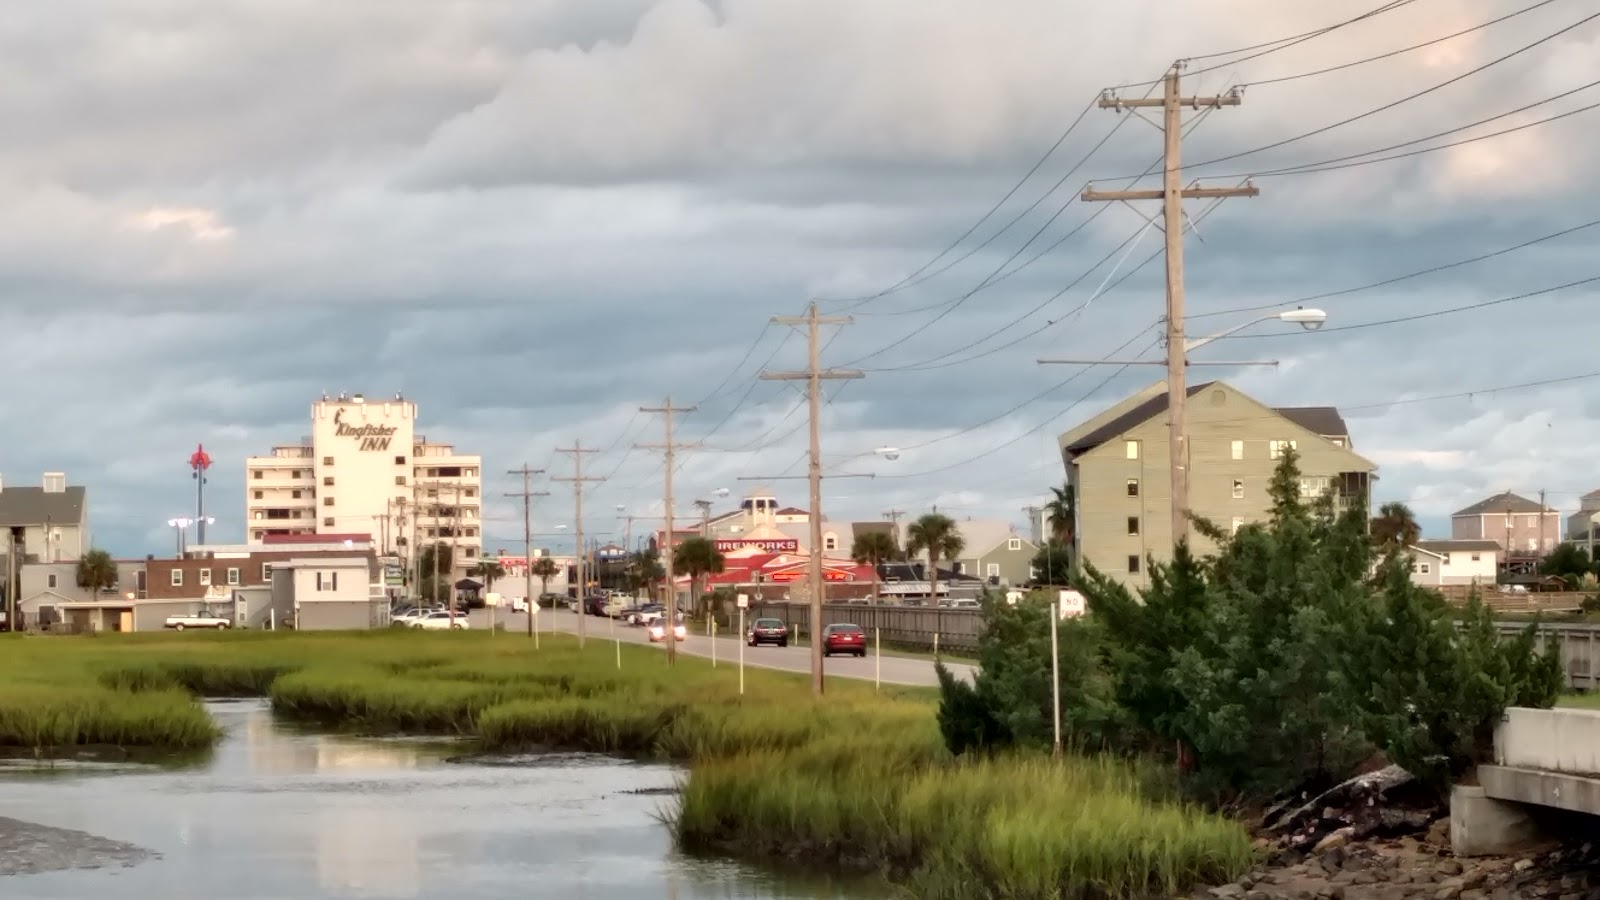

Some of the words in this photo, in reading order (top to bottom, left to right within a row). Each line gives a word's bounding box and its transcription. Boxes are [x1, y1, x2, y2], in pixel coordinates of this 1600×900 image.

[336, 422, 398, 440] Kingfisher
[359, 438, 392, 451] INN
[717, 541, 796, 550] IREWORKS
[1066, 598, 1078, 606] NO
